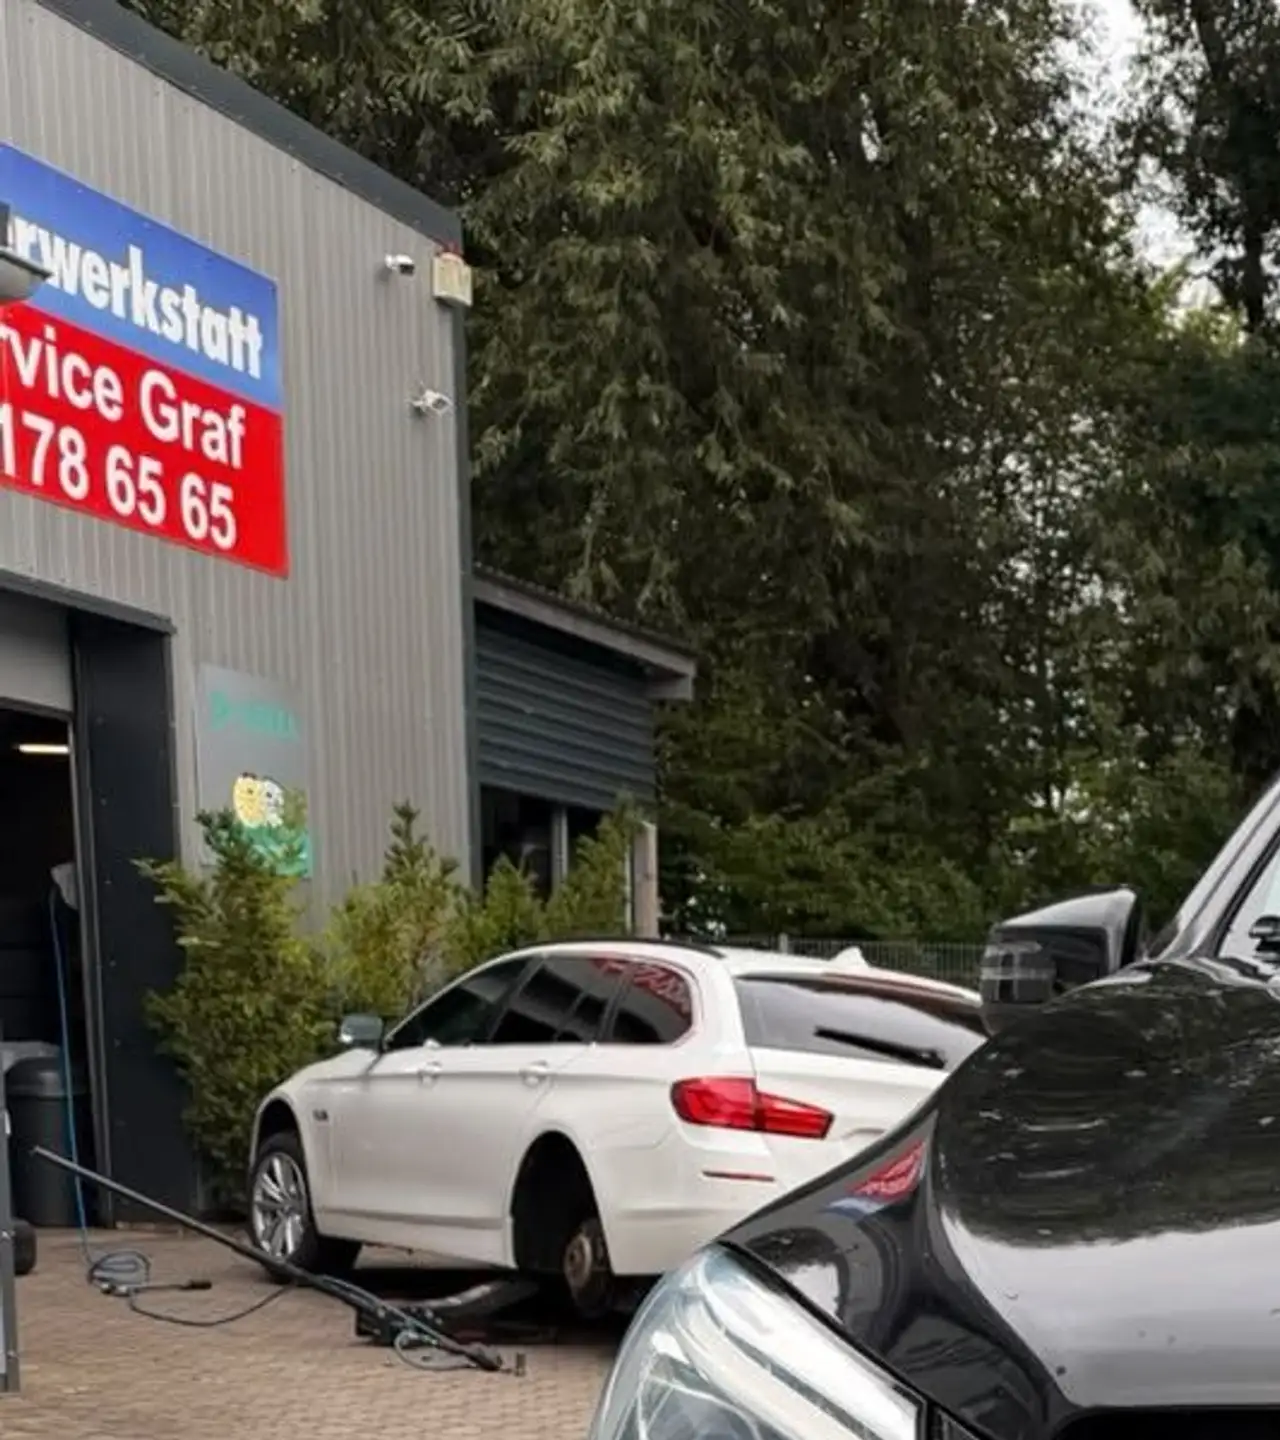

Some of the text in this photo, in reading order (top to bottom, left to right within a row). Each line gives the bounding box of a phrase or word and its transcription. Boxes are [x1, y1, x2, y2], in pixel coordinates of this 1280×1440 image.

[7, 216, 263, 379] rwerkstatt
[0, 403, 237, 551] 178 65 65
[140, 370, 246, 469] Graf
